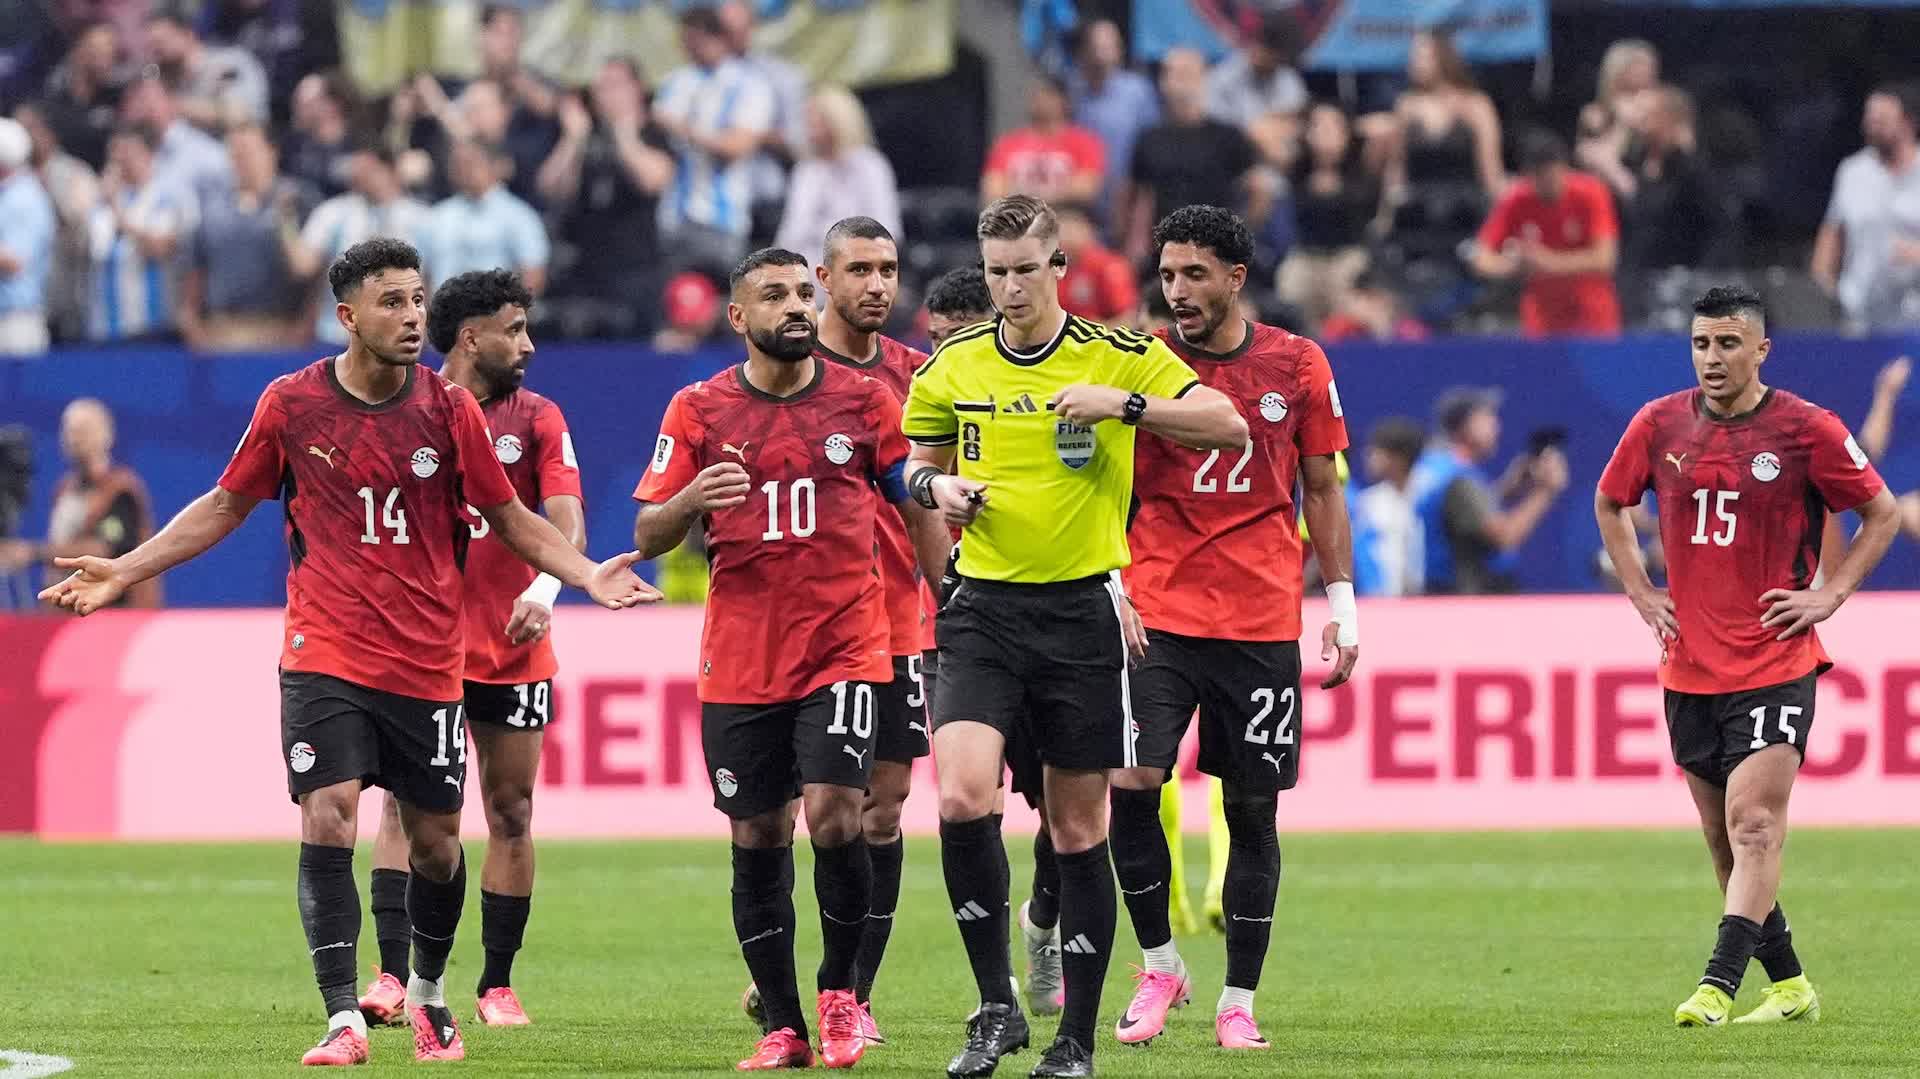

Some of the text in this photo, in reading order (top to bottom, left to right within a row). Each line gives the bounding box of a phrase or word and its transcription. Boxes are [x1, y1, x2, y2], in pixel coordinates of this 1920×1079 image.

[1058, 423, 1092, 434] FIFA
[1193, 438, 1254, 493] 22
[357, 487, 410, 545] 14
[761, 477, 816, 541] 10
[1691, 488, 1740, 547] 15
[506, 681, 549, 728] 19
[827, 681, 872, 739] 10
[1244, 687, 1295, 745] 22
[1749, 705, 1803, 750] 15
[430, 704, 466, 766] 14
